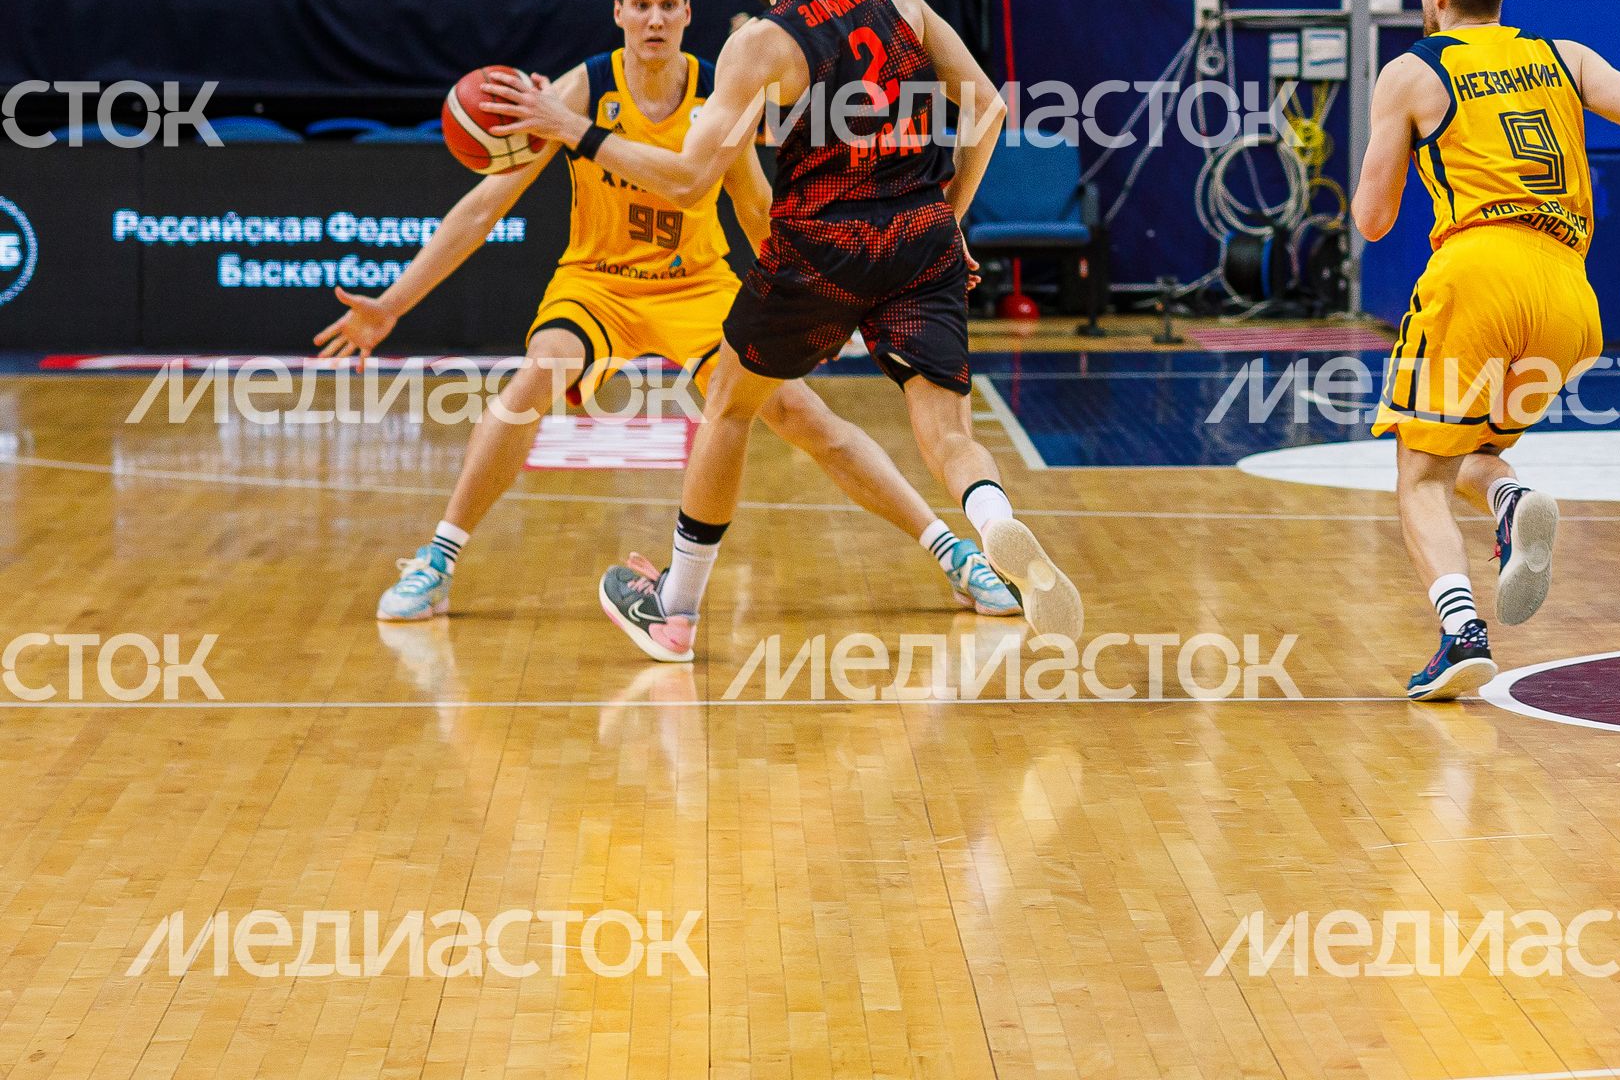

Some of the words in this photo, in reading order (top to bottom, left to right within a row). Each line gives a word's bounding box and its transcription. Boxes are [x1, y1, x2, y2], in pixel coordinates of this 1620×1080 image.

[848, 26, 900, 113] 2
[1453, 63, 1562, 102] НЕЗВАНКИН
[1498, 109, 1567, 195] 9
[112, 208, 323, 243] Российская
[629, 203, 684, 249] 99
